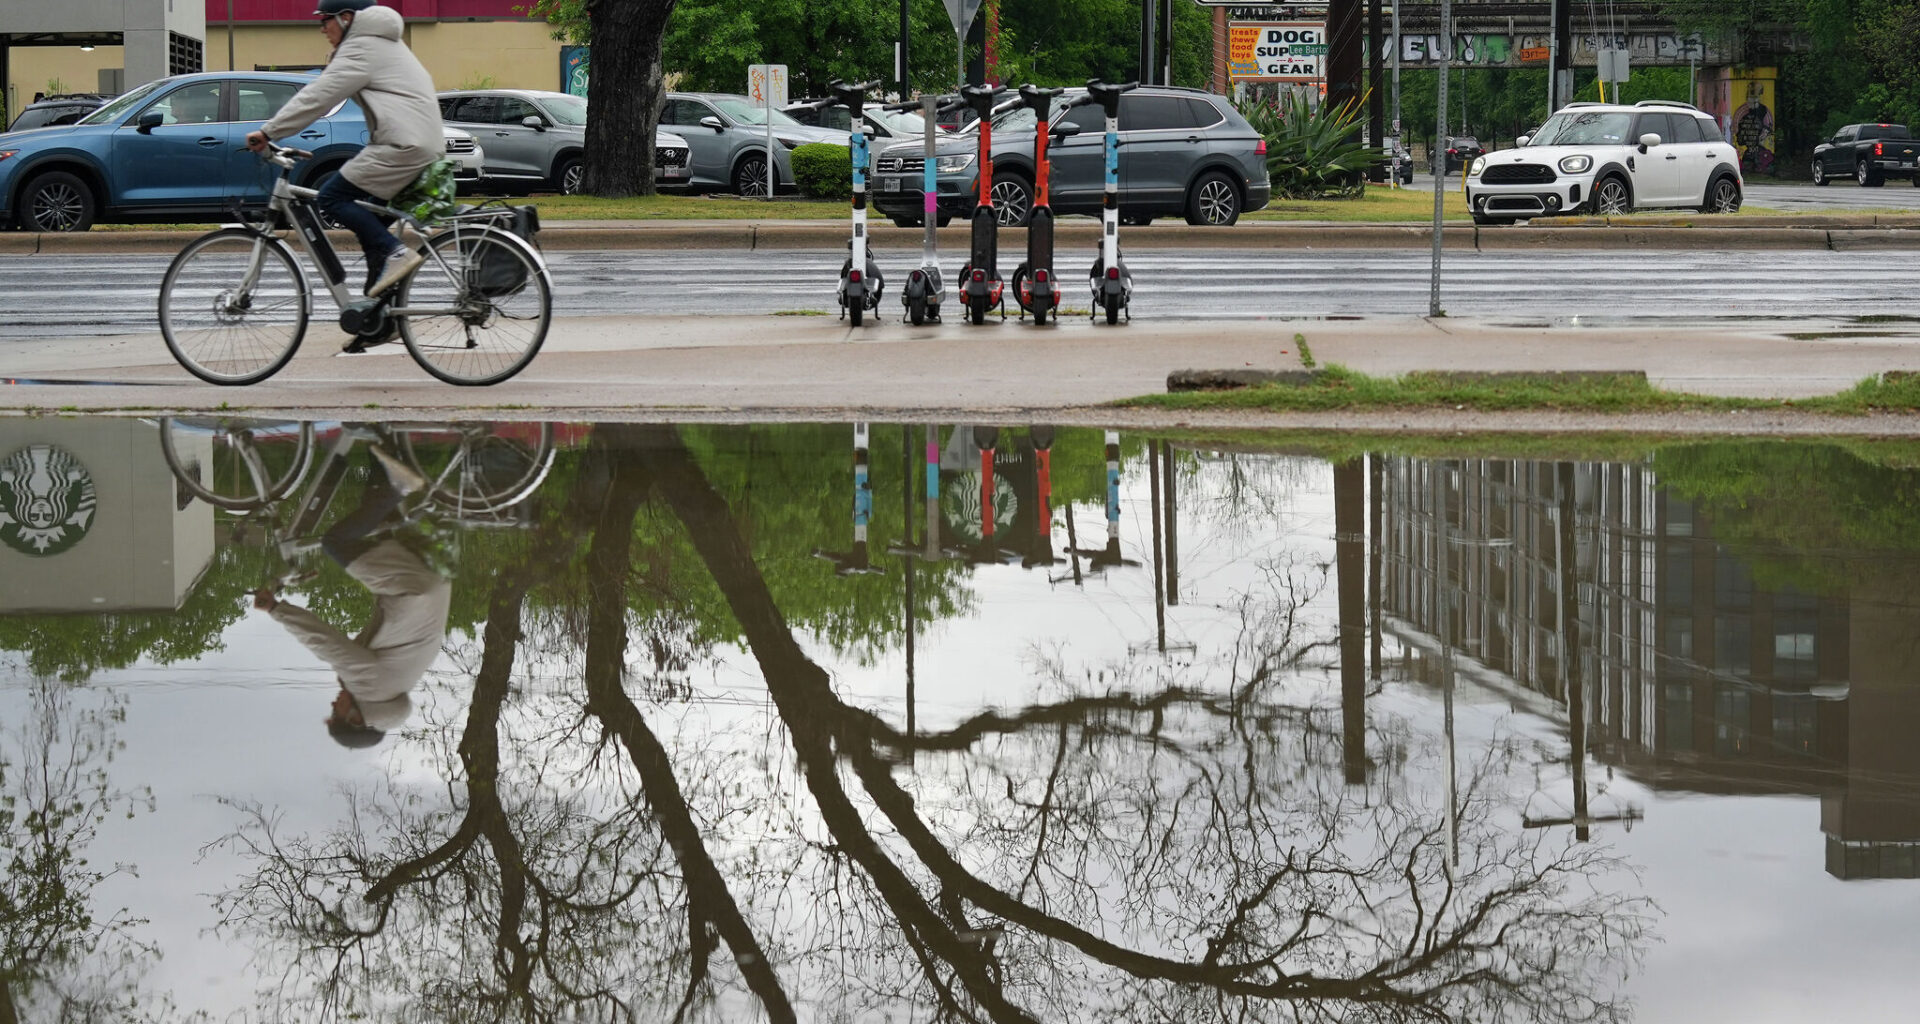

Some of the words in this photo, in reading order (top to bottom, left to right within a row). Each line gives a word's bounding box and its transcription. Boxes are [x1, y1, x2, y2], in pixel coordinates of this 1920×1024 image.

[1231, 28, 1258, 36] treats
[1267, 30, 1314, 43] DOG
[1289, 45, 1304, 54] Lee
[1305, 45, 1328, 54] Barto
[1231, 51, 1251, 59] toys
[1267, 64, 1314, 74] GEAR
